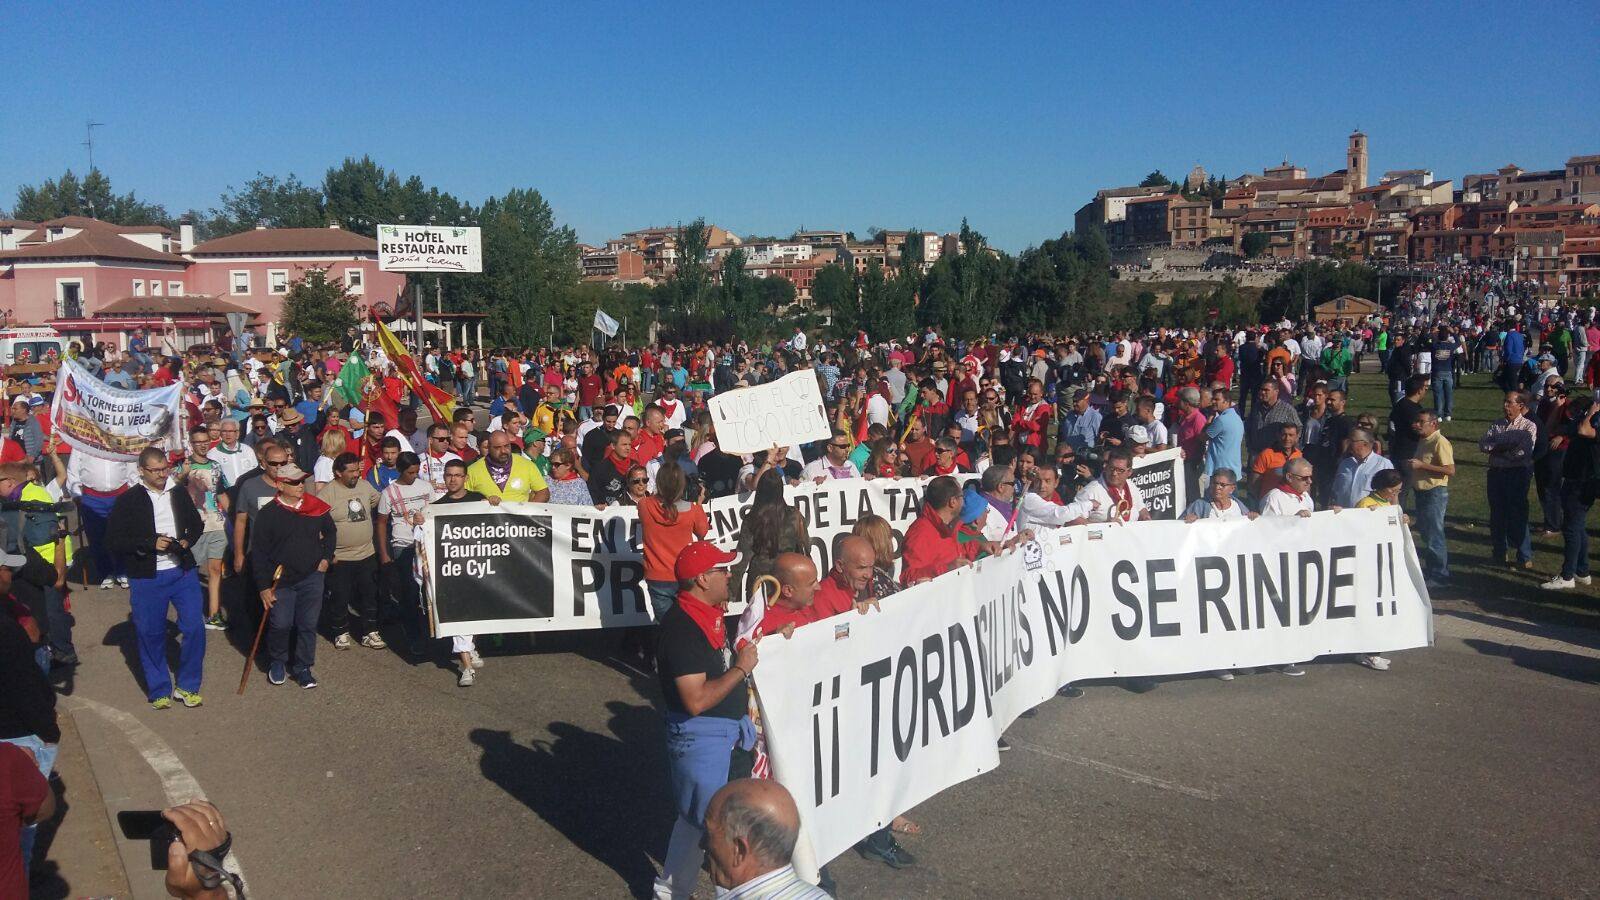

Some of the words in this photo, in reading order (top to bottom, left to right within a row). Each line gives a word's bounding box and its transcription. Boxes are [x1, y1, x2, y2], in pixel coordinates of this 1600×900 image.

[405, 232, 444, 243] HOTEL
[382, 243, 468, 255] RESTAURANTE
[87, 394, 124, 413] TORNEO
[126, 402, 144, 413] DEL
[98, 412, 110, 425] DE
[113, 415, 124, 427] LA
[128, 413, 151, 427] VEGA
[1140, 484, 1172, 500] aurinas
[1153, 495, 1172, 512] CyL
[571, 517, 617, 554] EN
[793, 491, 830, 528] DE
[840, 488, 876, 526] LA
[441, 522, 547, 541] Asociaciones
[441, 541, 511, 559] Taurinas
[441, 560, 462, 577] de
[466, 559, 496, 579] CyL
[1037, 564, 1090, 657] NO
[1110, 558, 1181, 641] SE
[1194, 545, 1356, 634] RINDE
[1377, 542, 1397, 617] !!
